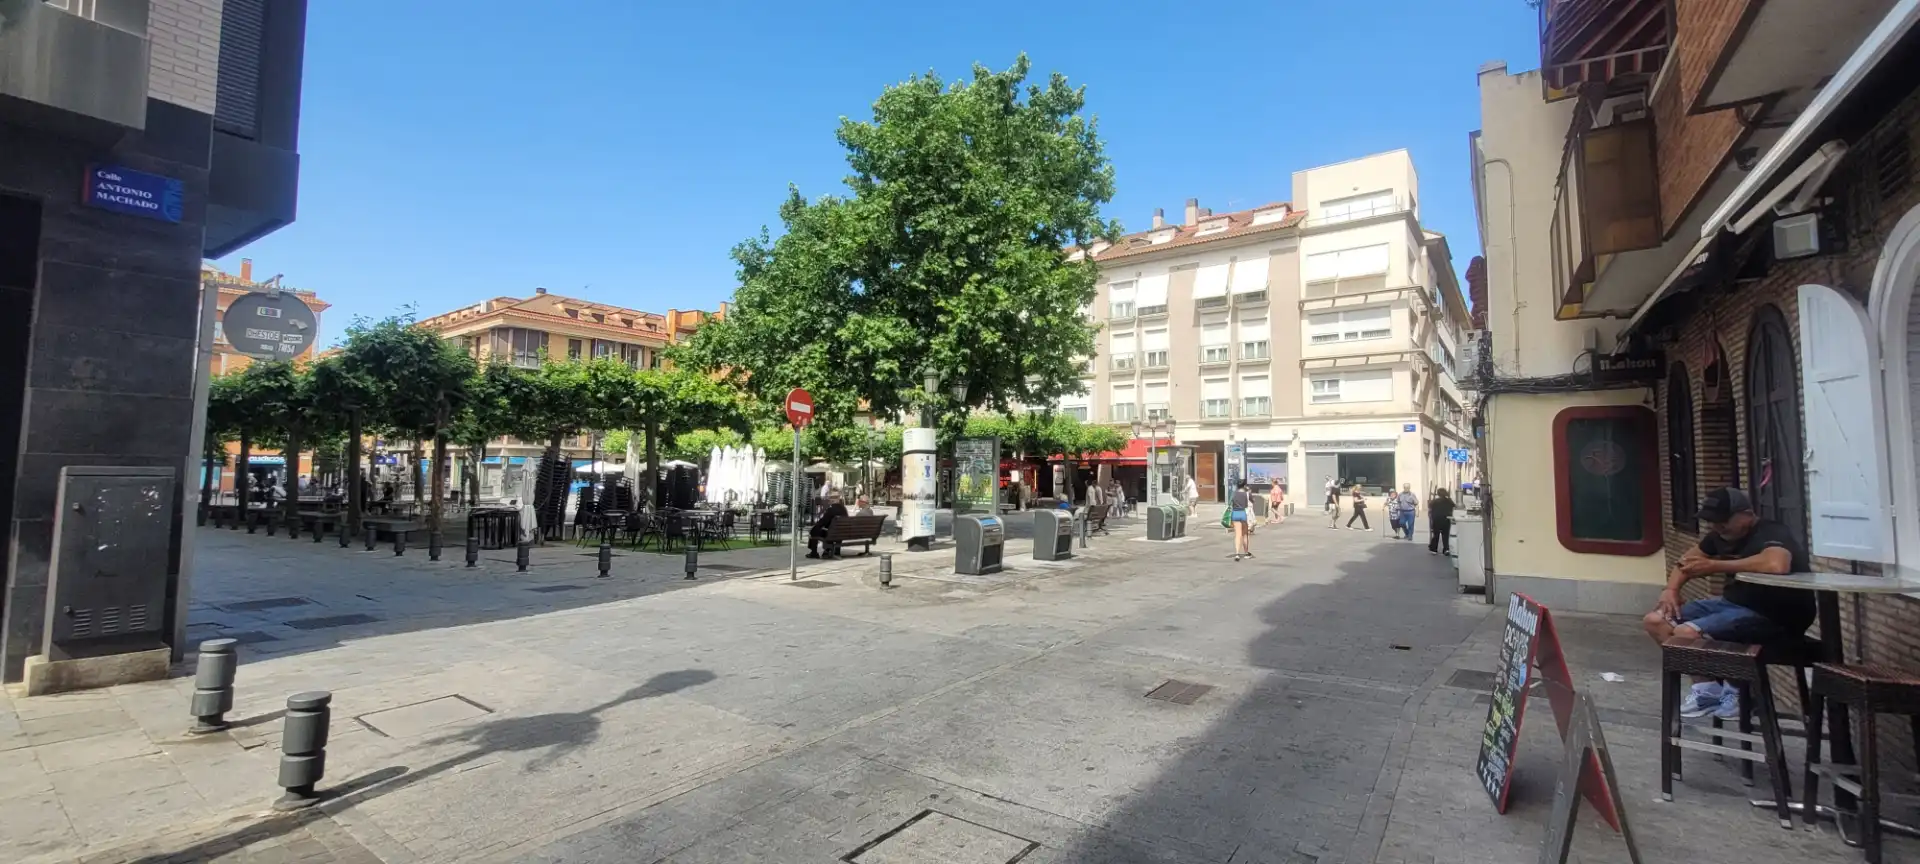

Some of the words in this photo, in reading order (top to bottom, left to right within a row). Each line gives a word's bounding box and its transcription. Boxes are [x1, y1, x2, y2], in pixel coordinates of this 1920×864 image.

[97, 171, 122, 181] Calle
[97, 182, 152, 199] ANTONIO
[96, 192, 158, 210] MACHADO
[1508, 593, 1538, 636] Mahou
